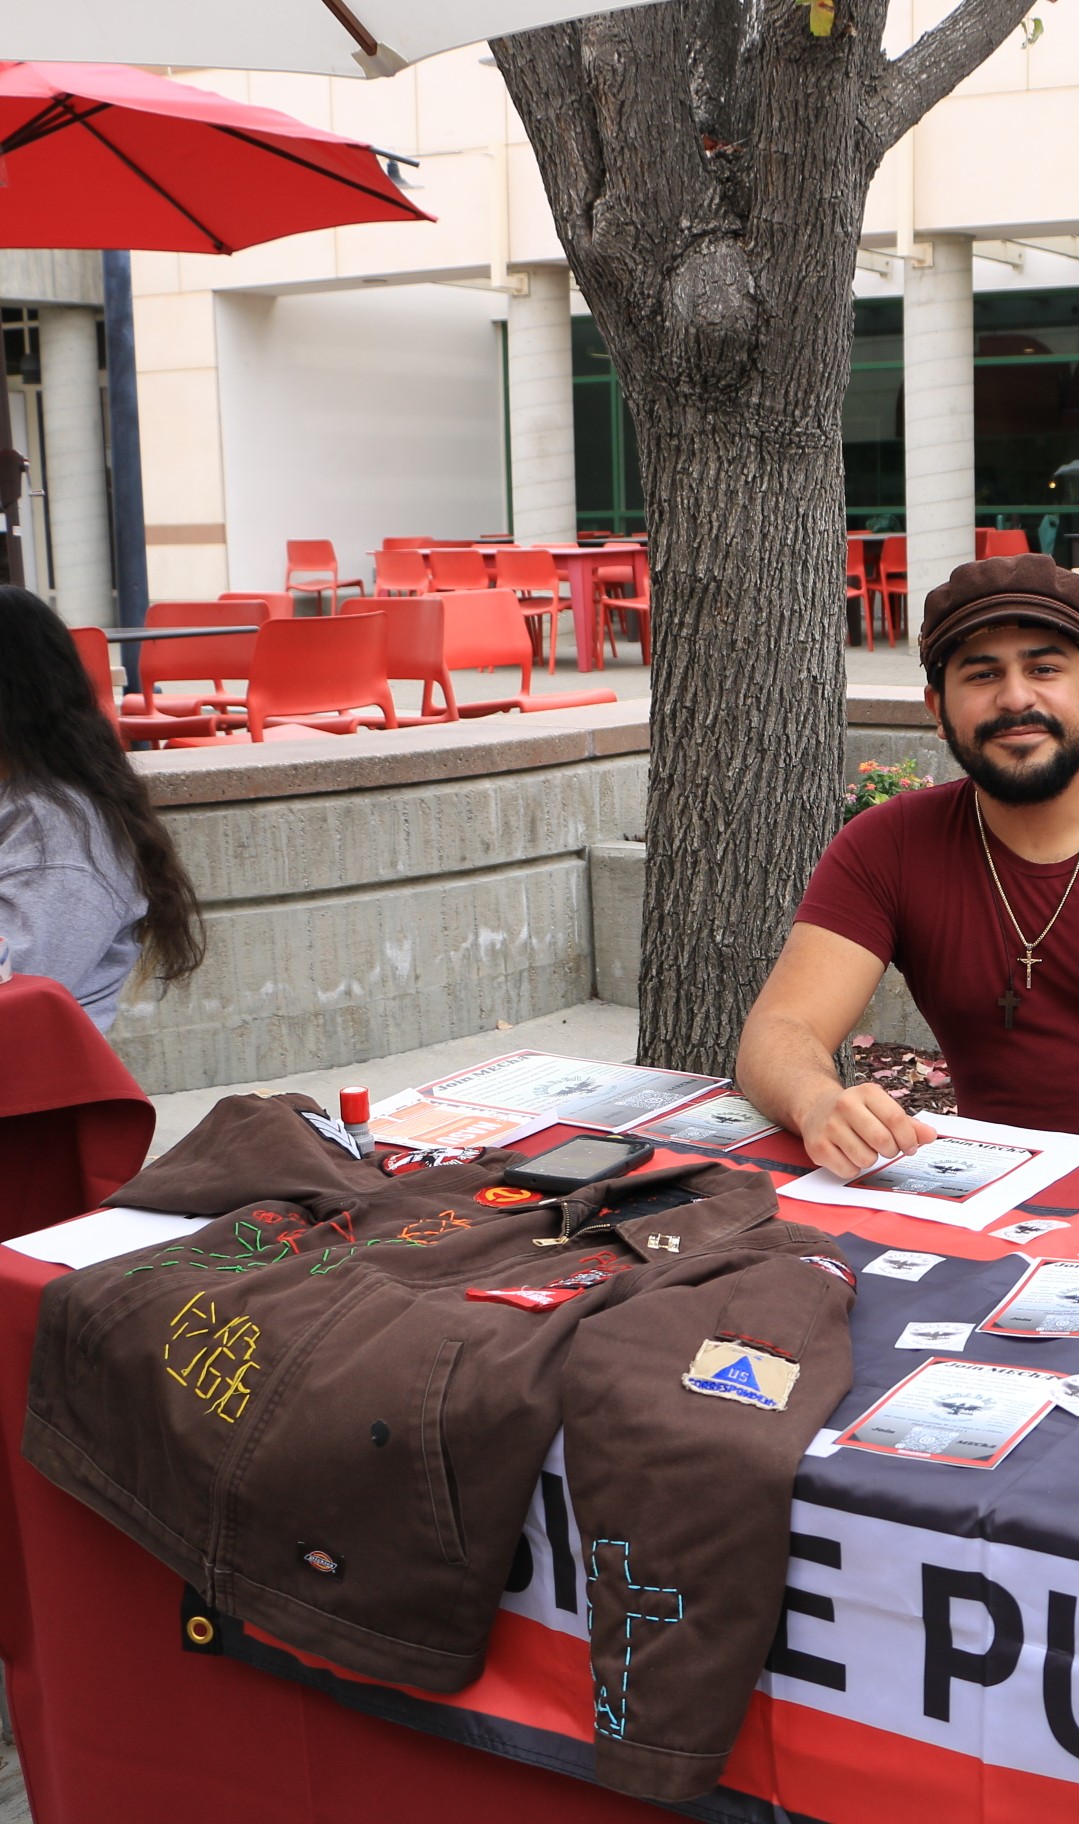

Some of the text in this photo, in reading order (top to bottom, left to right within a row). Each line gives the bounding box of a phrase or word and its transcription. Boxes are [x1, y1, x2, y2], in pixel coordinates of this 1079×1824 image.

[437, 1074, 472, 1093] Join
[434, 1120, 503, 1145] NASU
[943, 1138, 973, 1148] Join
[945, 1360, 985, 1372] Join
[728, 1368, 750, 1382] US
[765, 1530, 847, 1692] E
